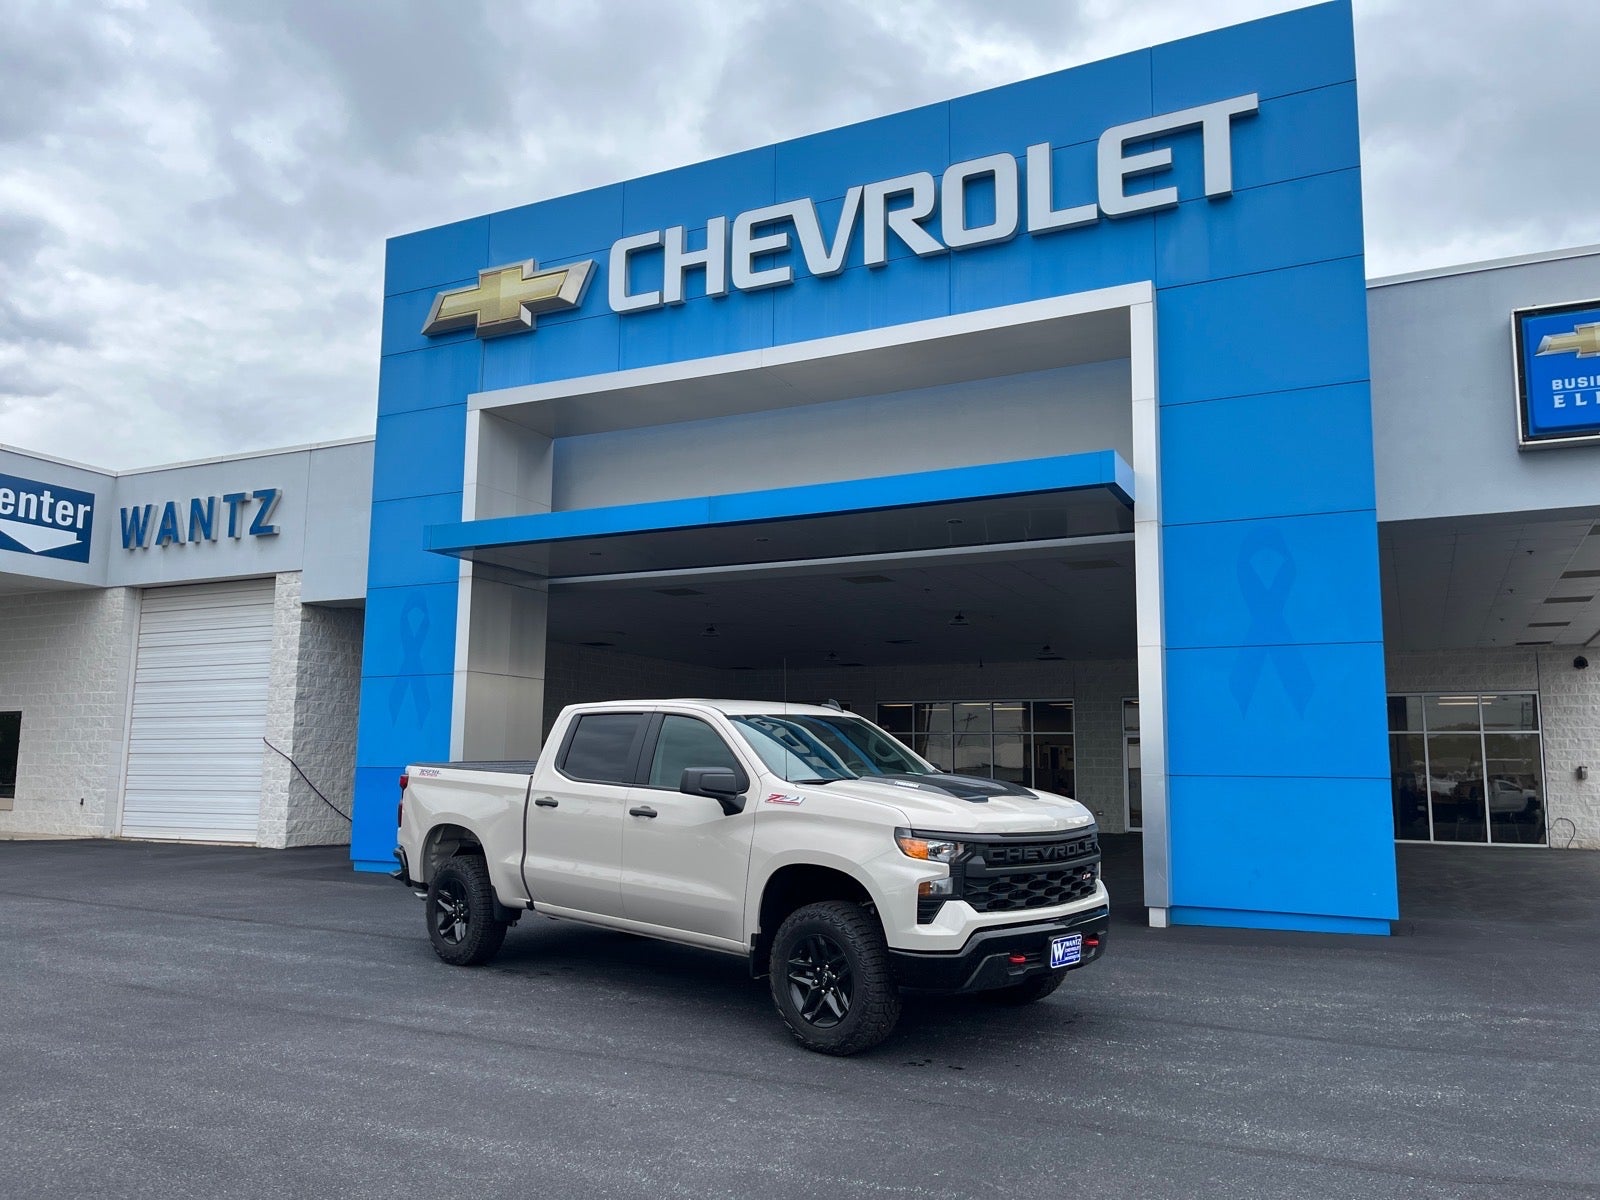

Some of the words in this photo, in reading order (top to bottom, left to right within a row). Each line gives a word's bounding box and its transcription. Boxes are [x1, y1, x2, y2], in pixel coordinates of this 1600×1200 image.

[608, 92, 1259, 315] CHEVROLET
[0, 487, 91, 529] enter
[120, 488, 282, 550] WANTZ
